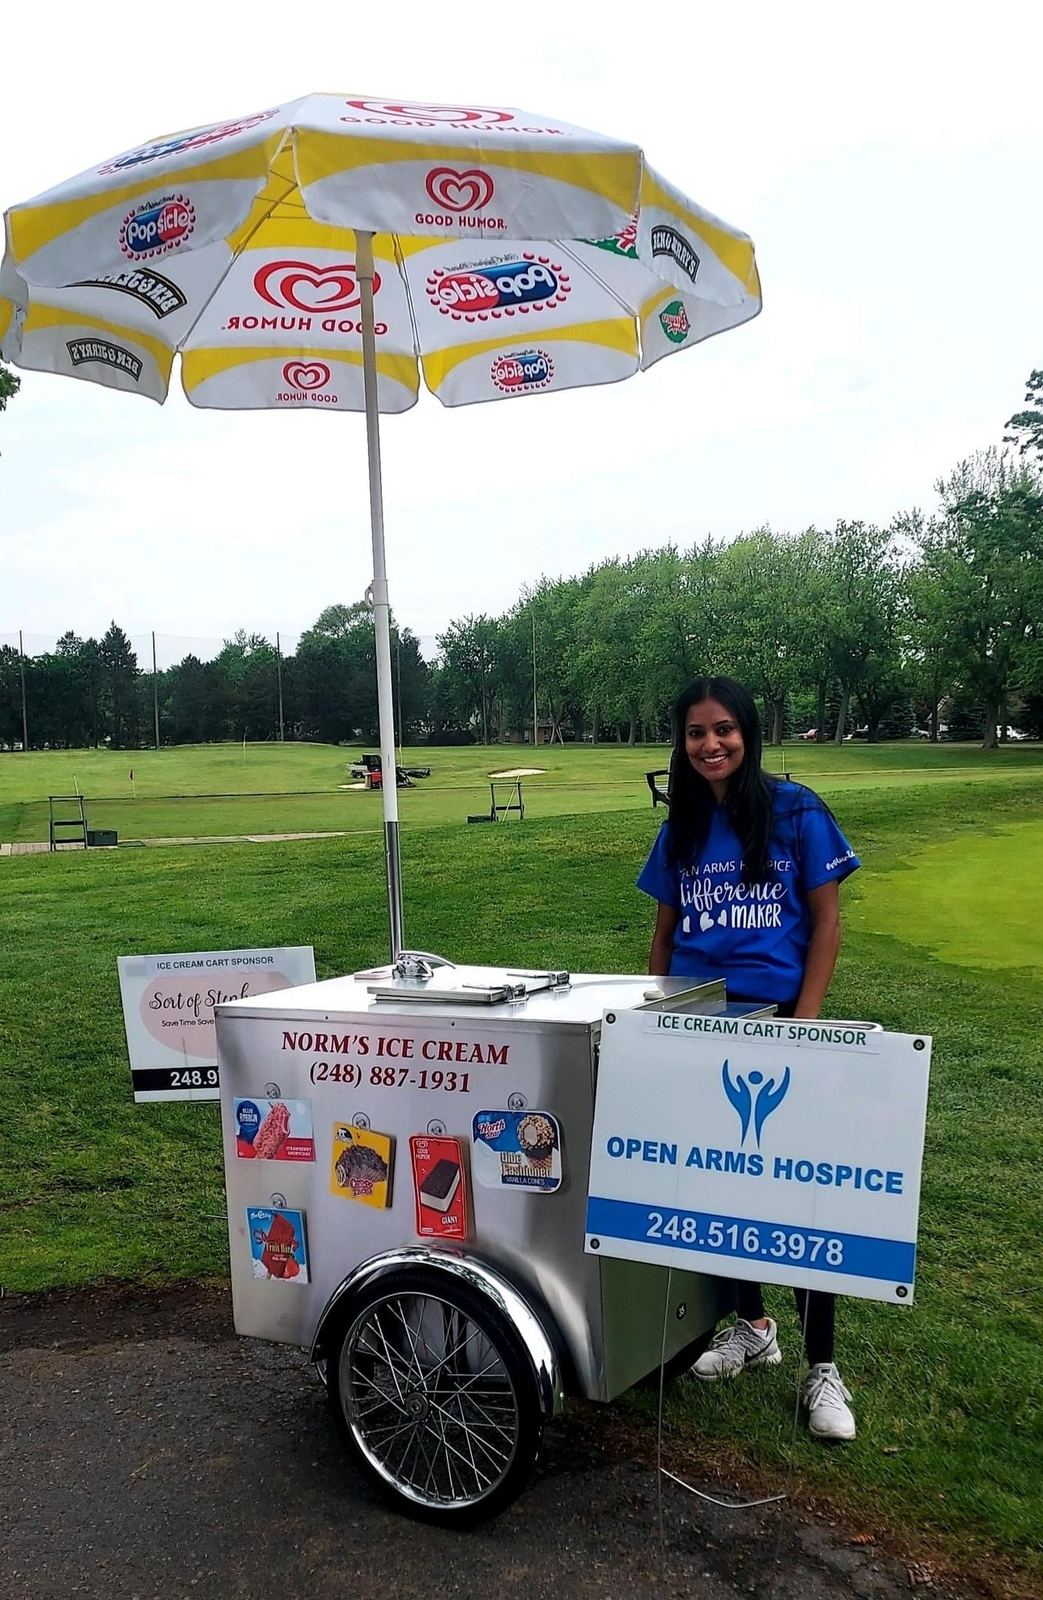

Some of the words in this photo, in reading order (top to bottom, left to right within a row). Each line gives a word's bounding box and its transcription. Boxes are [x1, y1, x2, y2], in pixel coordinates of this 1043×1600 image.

[340, 116, 436, 128] GOOD
[415, 213, 453, 227] GOOD
[702, 860, 736, 875] ARMS
[739, 859, 792, 873] HPICE
[156, 961, 171, 970] ICE
[173, 960, 204, 969] CREAM
[206, 958, 229, 967] CART
[231, 956, 274, 966] SPONSOR
[149, 991, 185, 1010] Sort
[186, 992, 202, 1018] of
[161, 1018, 179, 1027] Save
[180, 1018, 196, 1027] Time
[197, 1017, 215, 1026] Save
[657, 1015, 680, 1029] ICE
[683, 1017, 738, 1035] CREAM
[743, 1022, 785, 1038] CART
[787, 1026, 866, 1046] SPONSOR
[281, 1031, 370, 1055] NORM'S
[376, 1036, 415, 1059] ICE
[421, 1040, 511, 1065] CREAM
[170, 1069, 219, 1087] 248.9
[309, 1061, 363, 1088] (248)
[369, 1066, 471, 1093] 887-1931
[478, 1118, 506, 1133] North
[606, 1136, 678, 1165] OPEN
[685, 1146, 764, 1176] ARMS
[773, 1157, 904, 1195] HOSPICE
[505, 1176, 527, 1184] VANILLA
[441, 1216, 458, 1225] GIANT
[646, 1212, 844, 1266] 248.516.3978
